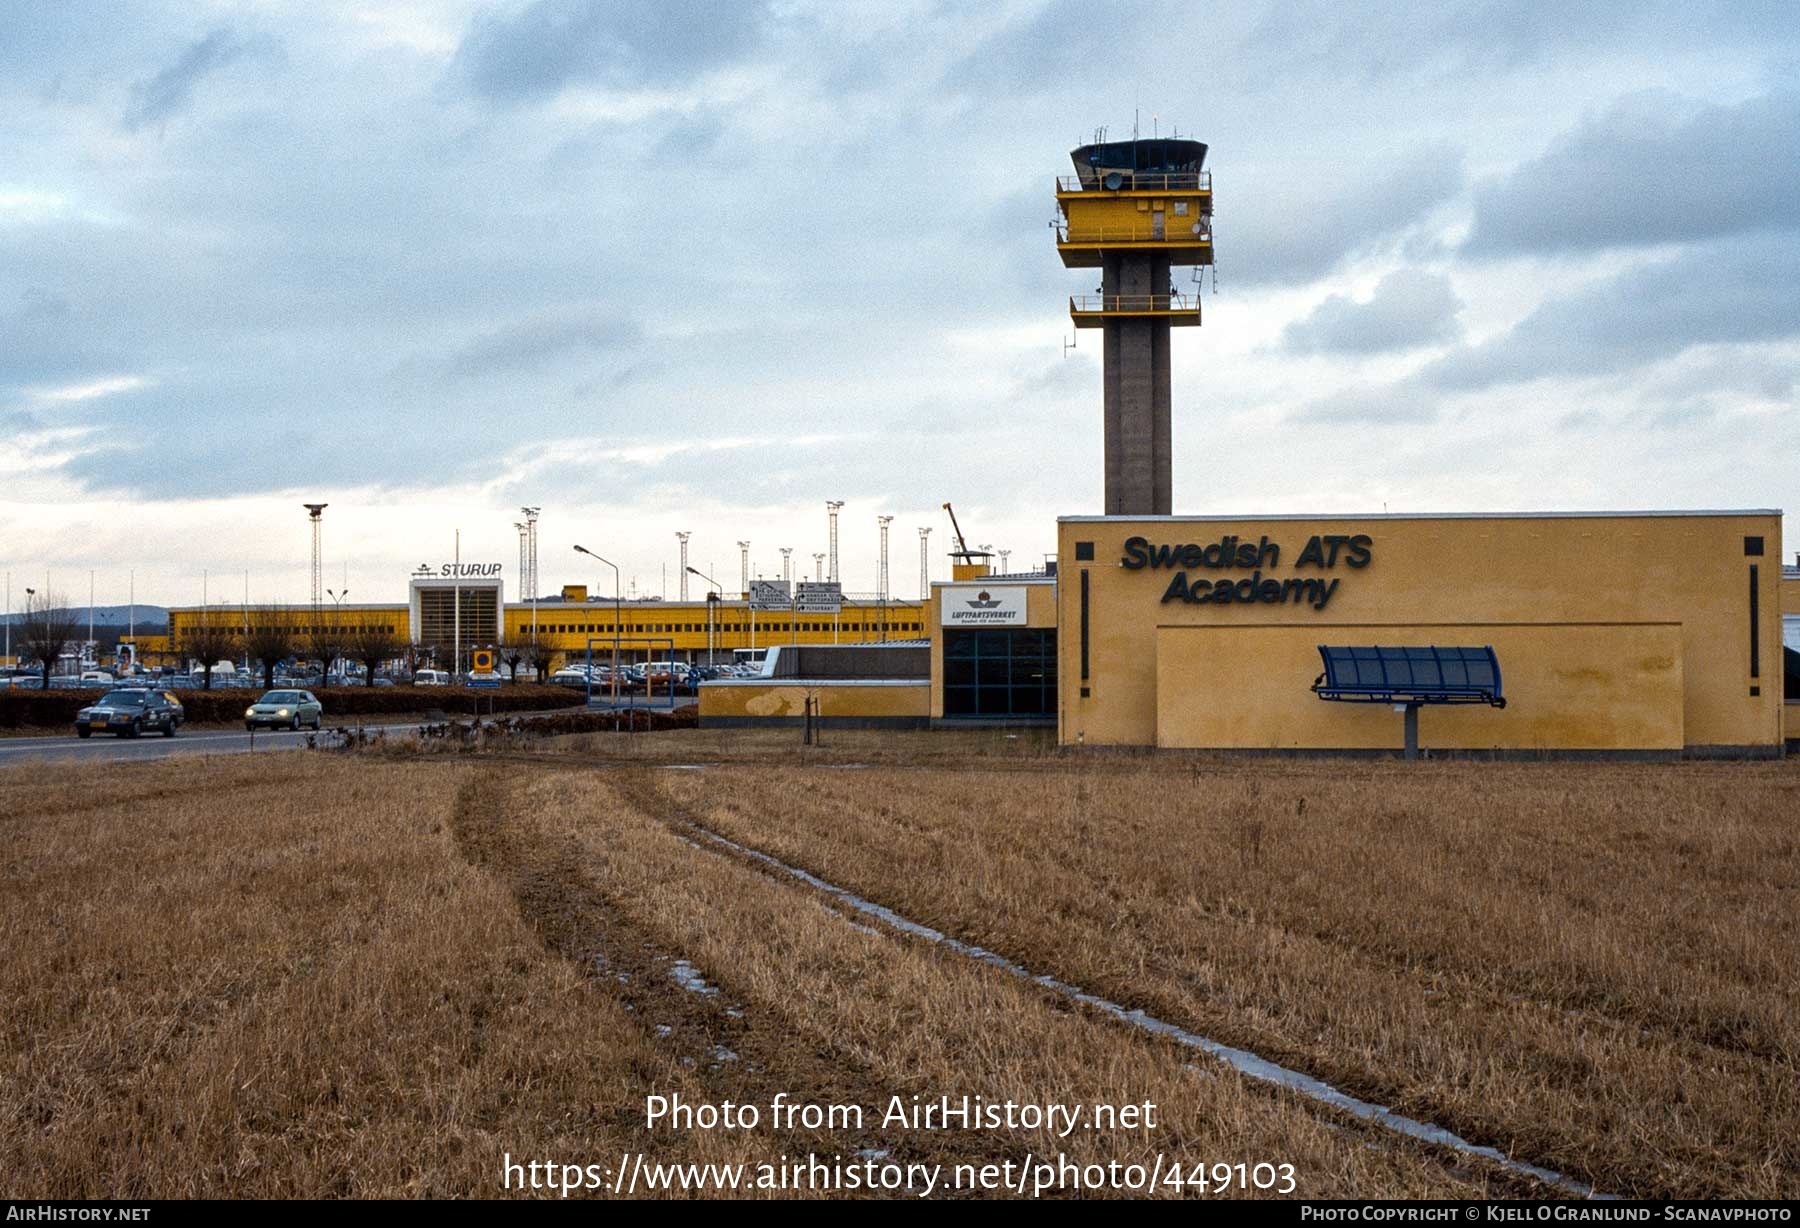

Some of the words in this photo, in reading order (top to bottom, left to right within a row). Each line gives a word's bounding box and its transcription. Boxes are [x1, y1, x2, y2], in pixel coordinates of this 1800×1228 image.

[1122, 535, 1281, 570] Swedish
[1295, 534, 1373, 569] ATS
[441, 563, 502, 577] STURUP
[1160, 570, 1340, 611] Academy
[952, 611, 1017, 619] LUFTFARTSVERKET
